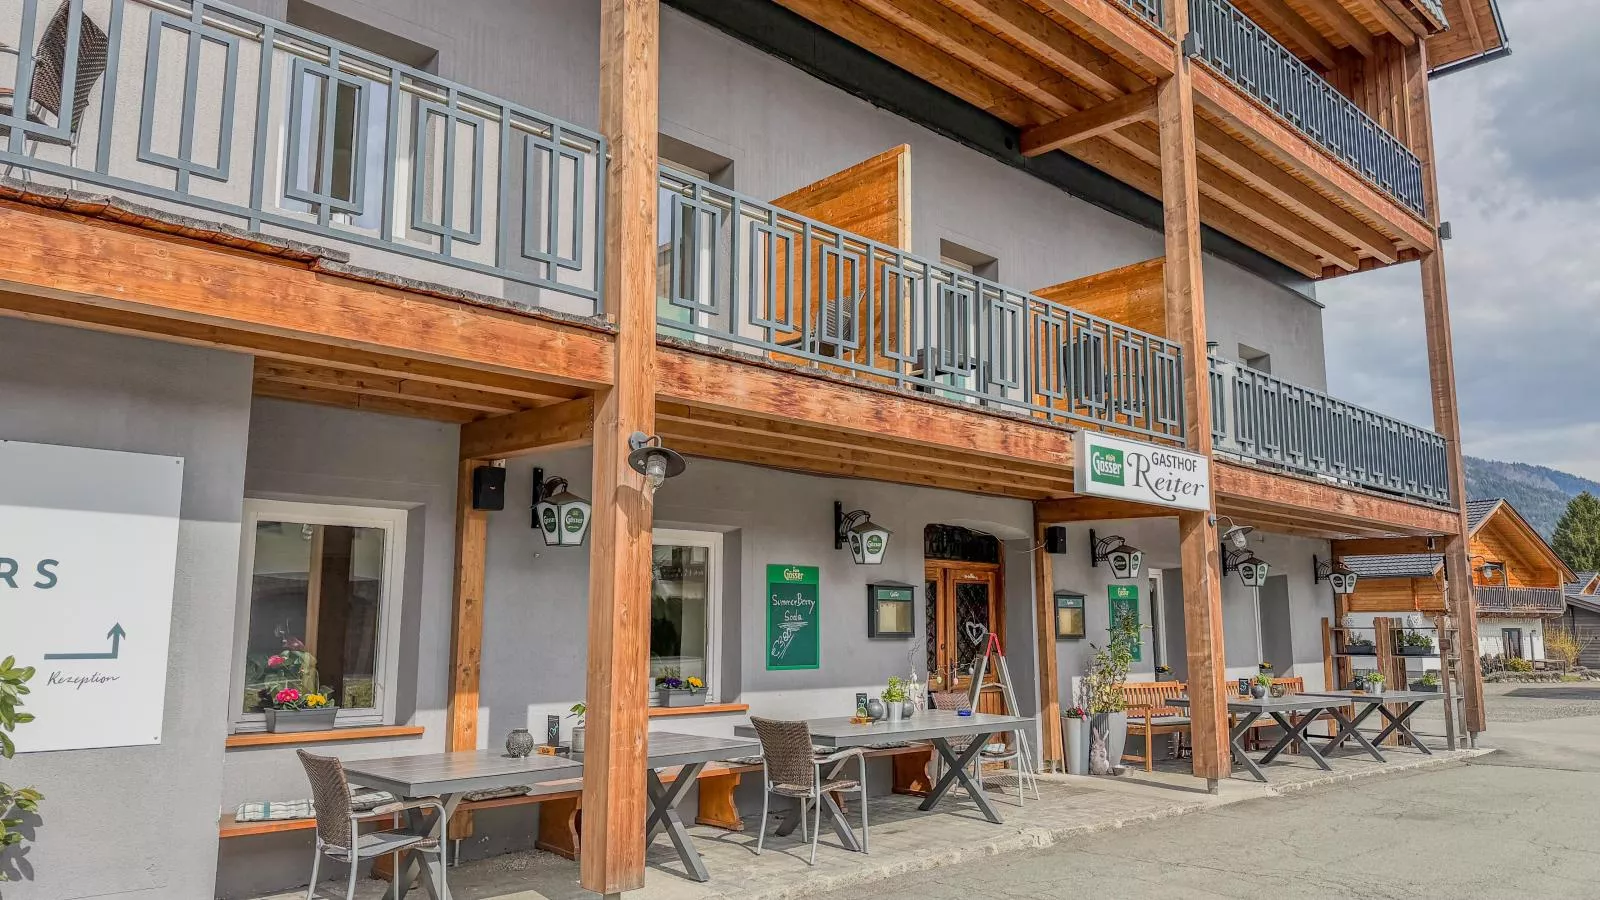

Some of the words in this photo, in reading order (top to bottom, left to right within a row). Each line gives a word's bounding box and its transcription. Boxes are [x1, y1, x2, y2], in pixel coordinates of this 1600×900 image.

[1092, 451, 1122, 475] Gösser
[1151, 451, 1198, 472] GASTHOF
[1126, 452, 1205, 502] Reiter
[784, 609, 803, 622] Soda
[46, 671, 121, 690] Rezeption
